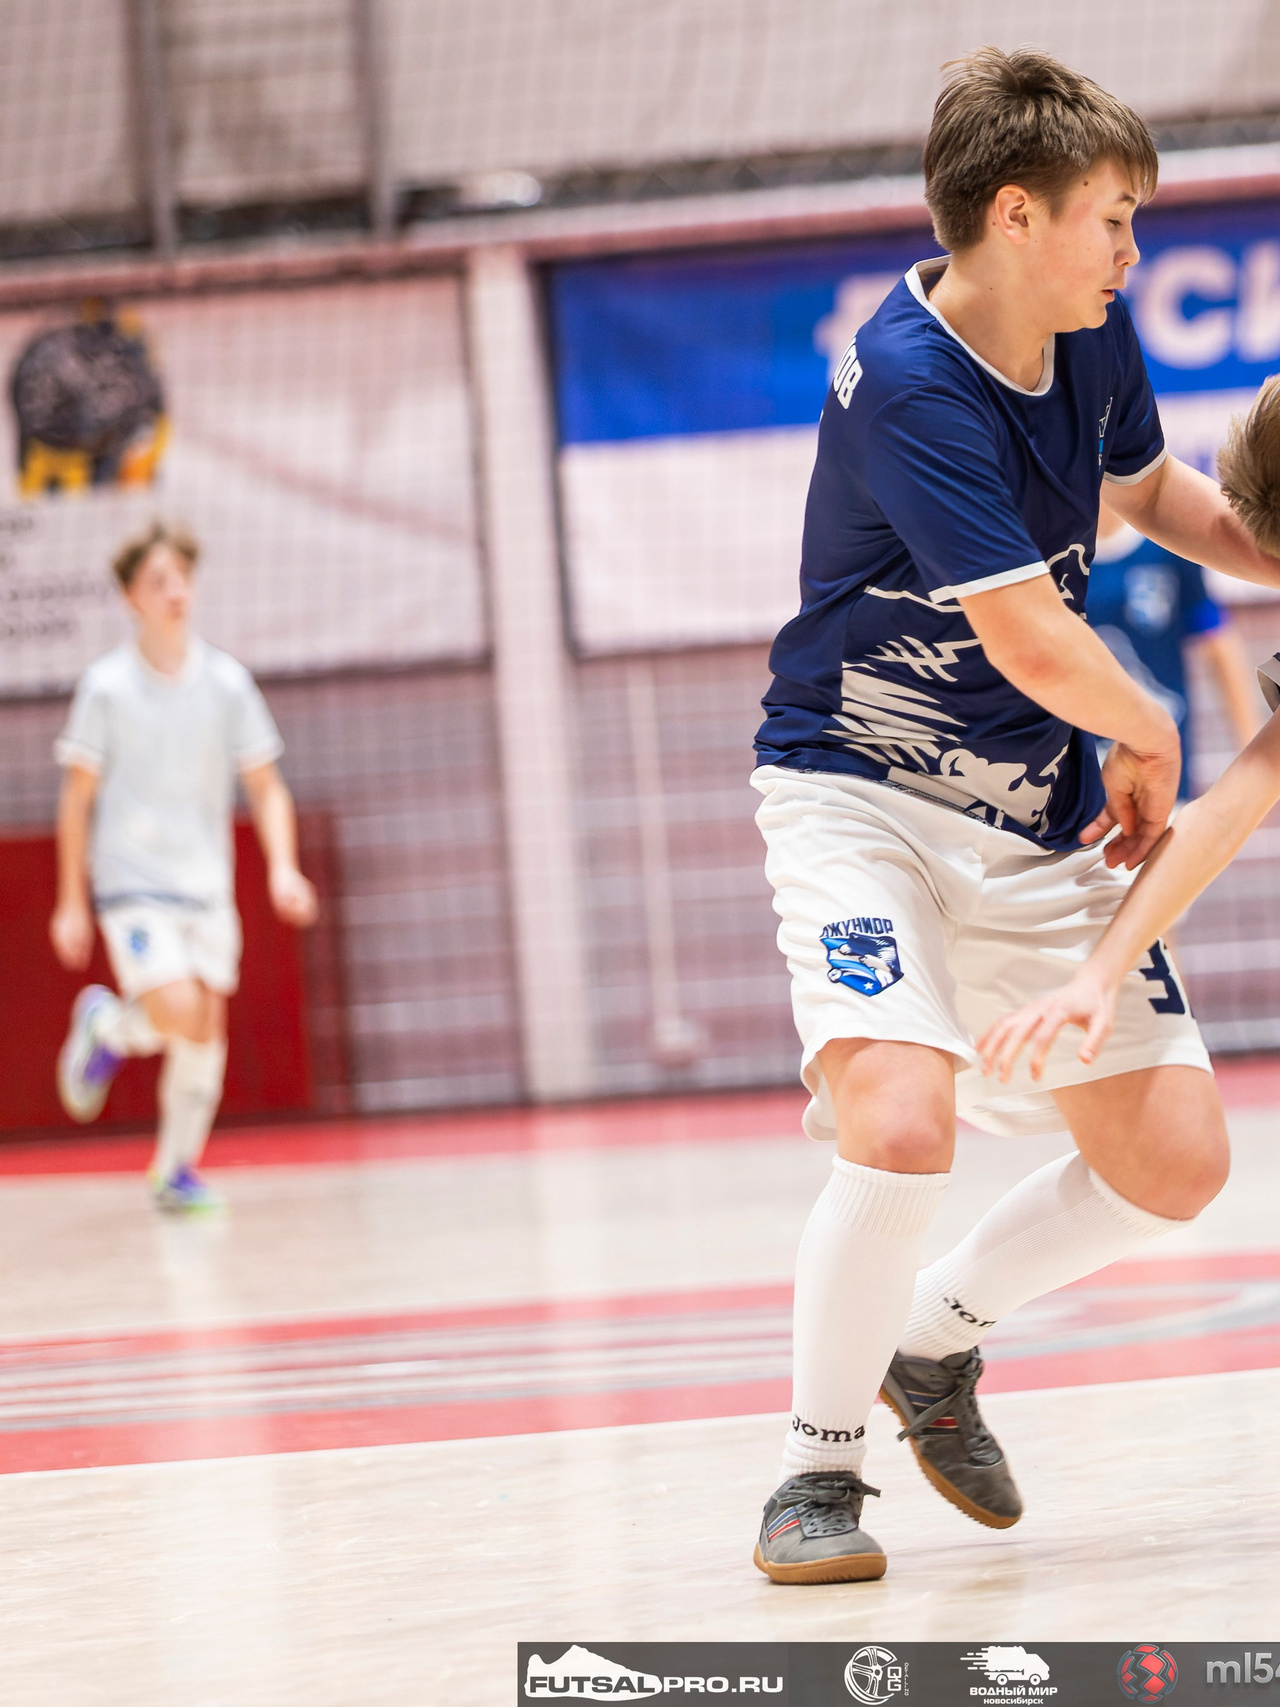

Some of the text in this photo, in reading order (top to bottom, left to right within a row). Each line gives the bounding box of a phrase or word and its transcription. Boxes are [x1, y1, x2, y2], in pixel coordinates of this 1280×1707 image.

[833, 336, 863, 410] ОВ
[819, 917, 894, 939] ДЖУНИОР
[1138, 939, 1190, 1016] 3
